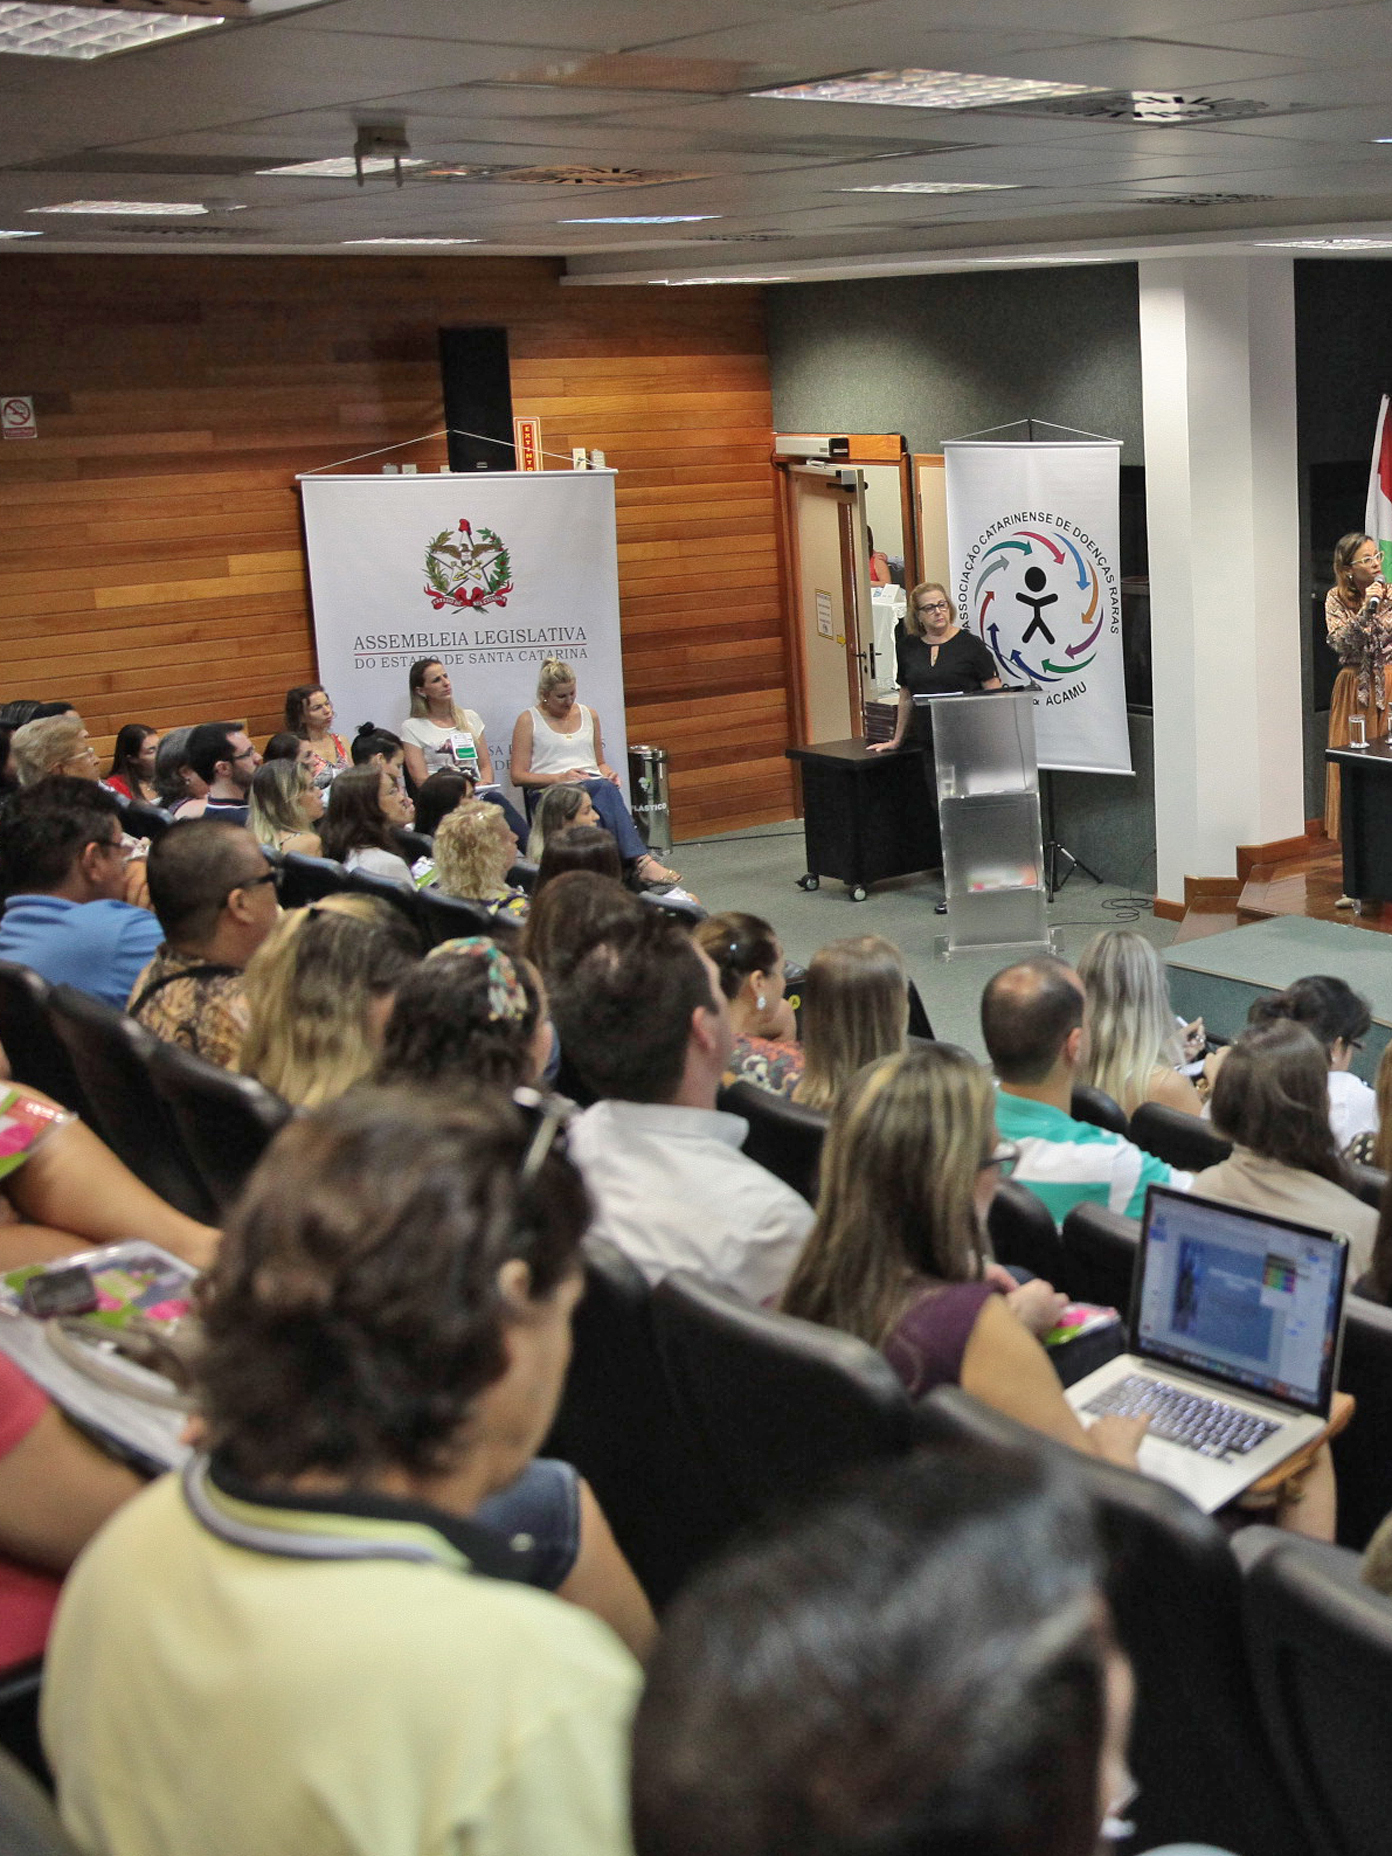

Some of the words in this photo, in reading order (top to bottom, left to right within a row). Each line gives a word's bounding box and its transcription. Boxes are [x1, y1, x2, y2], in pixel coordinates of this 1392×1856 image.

[524, 426, 534, 471] EXTINTO
[958, 544, 981, 629] ASSOCIAÇÃO
[979, 512, 1053, 545] CATARINENSE
[1055, 516, 1072, 532] DE
[1072, 527, 1115, 584] DOENÇAS
[1109, 586, 1119, 634] RARAS
[353, 632, 469, 650] ASSEMBLEIA
[474, 626, 587, 645] LEGISLATIVA
[355, 658, 376, 669] DO
[444, 654, 464, 665] DE
[469, 651, 514, 664] SANTA
[518, 648, 588, 661] CATARINA
[1046, 681, 1087, 706] ACAMU
